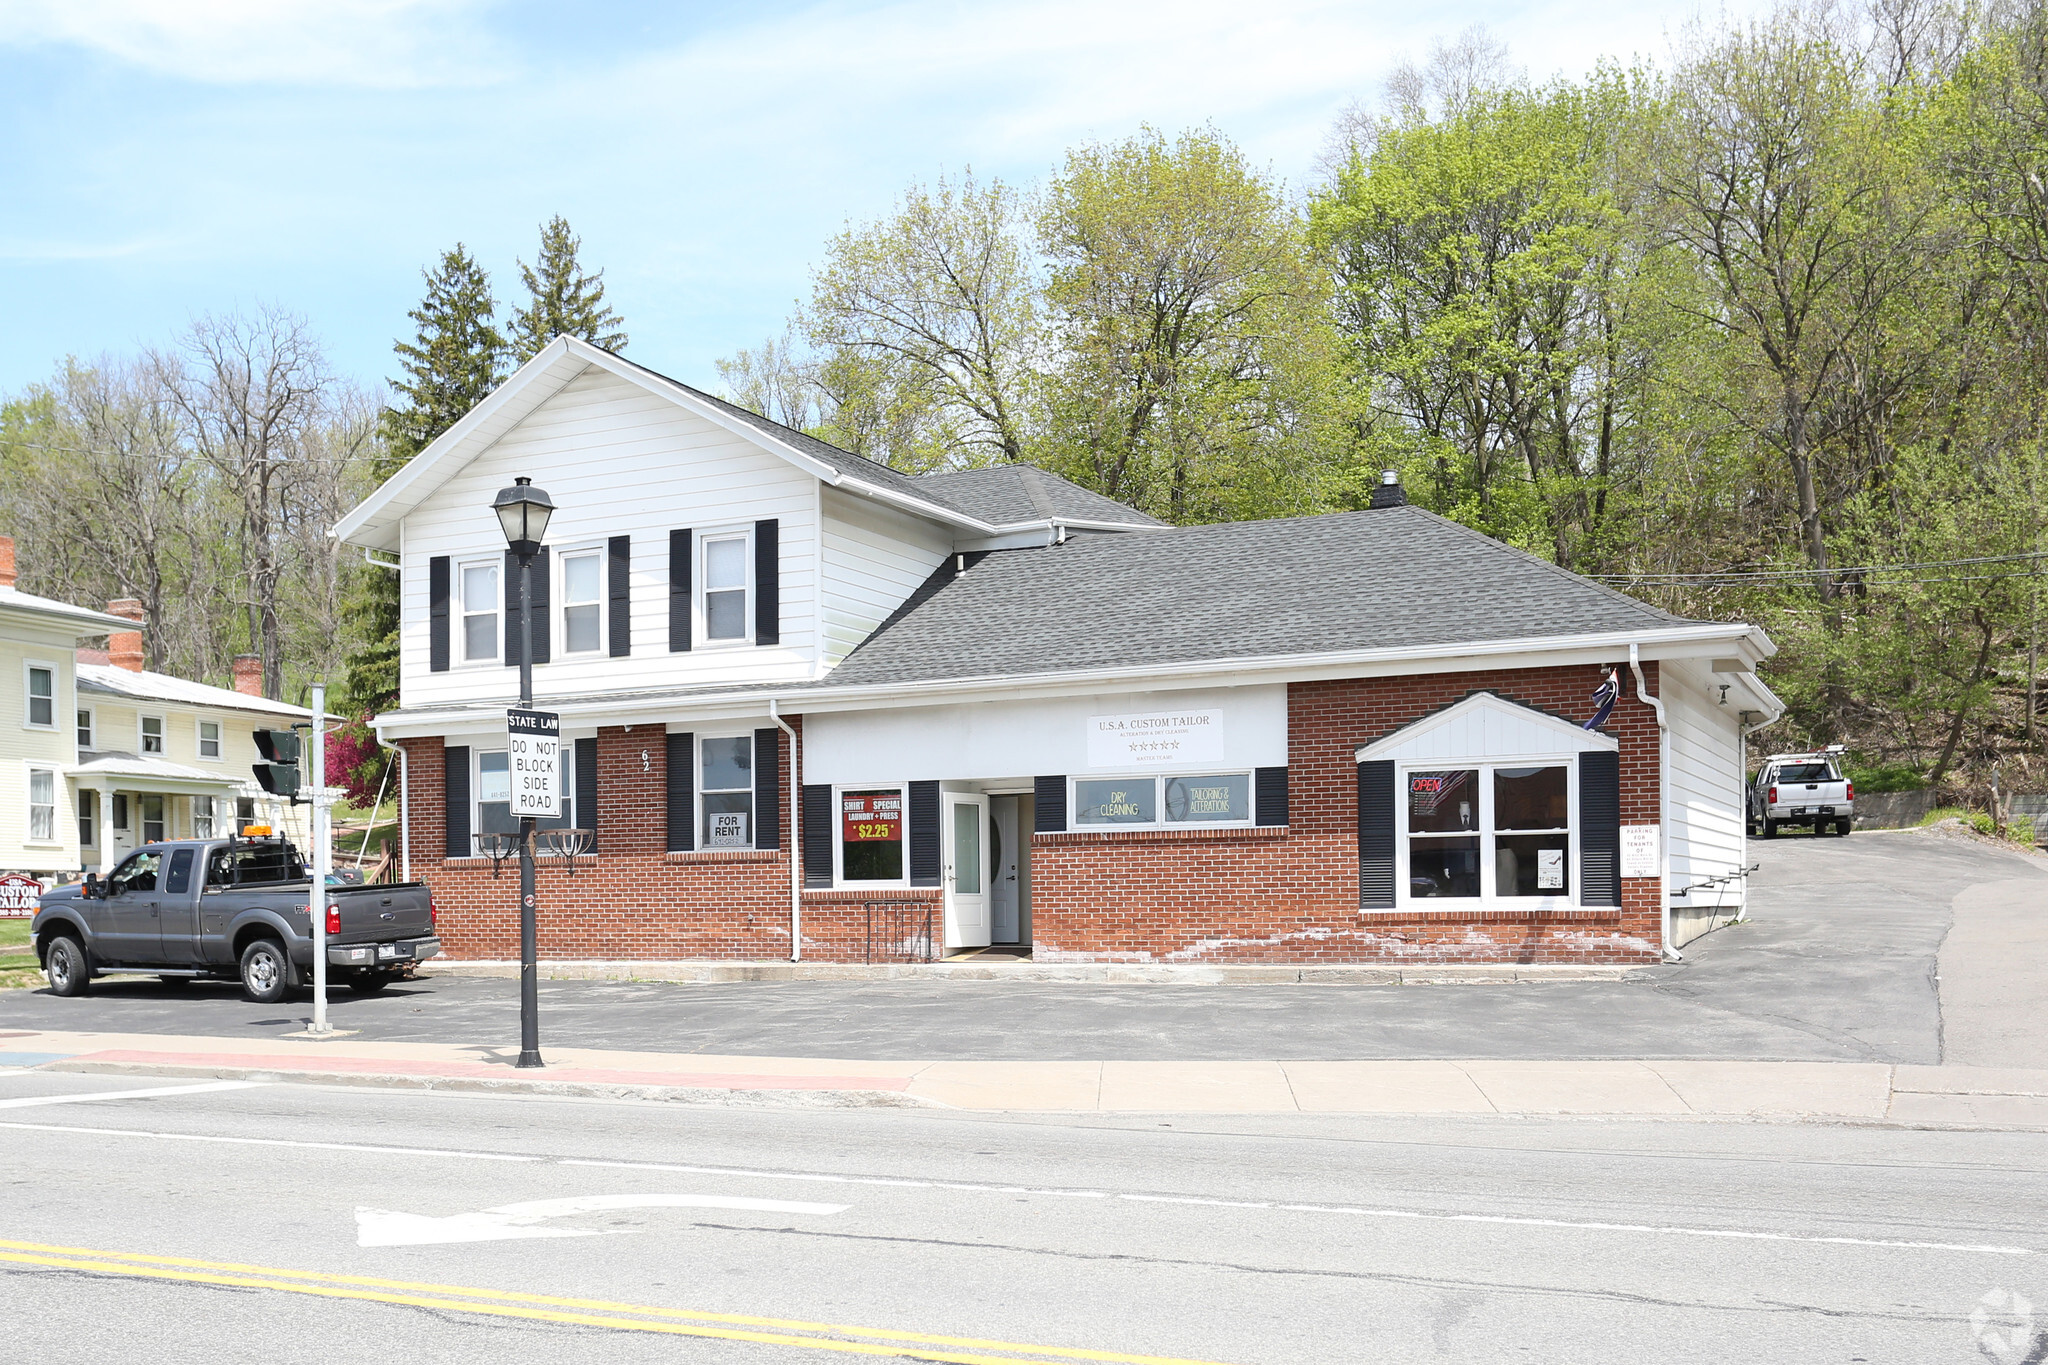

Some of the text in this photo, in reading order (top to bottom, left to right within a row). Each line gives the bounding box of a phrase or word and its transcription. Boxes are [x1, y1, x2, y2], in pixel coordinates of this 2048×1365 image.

[509, 715, 558, 730] STATE LAW
[1099, 715, 1210, 731] U.S.A. CUSTOM TAILOR
[512, 740, 557, 755] DO NOT
[516, 758, 554, 773] BLOCK
[523, 776, 549, 790] SIDE
[1413, 779, 1441, 791] OPEN
[1111, 791, 1127, 803] DRY
[1190, 787, 1229, 800] TAILORING &
[521, 794, 551, 808] ROAD
[844, 800, 901, 810] SHIRT SPECIAL
[1190, 800, 1230, 812] ALTERATIONS
[1100, 803, 1139, 816] CLEANING
[718, 816, 738, 826] FOR
[848, 812, 874, 821] LAUNDRY
[879, 812, 899, 820] PRESS
[715, 827, 741, 836] RENT
[858, 824, 889, 839] $2.25
[0, 885, 39, 897] USTOM
[0, 897, 36, 909] AILOR
